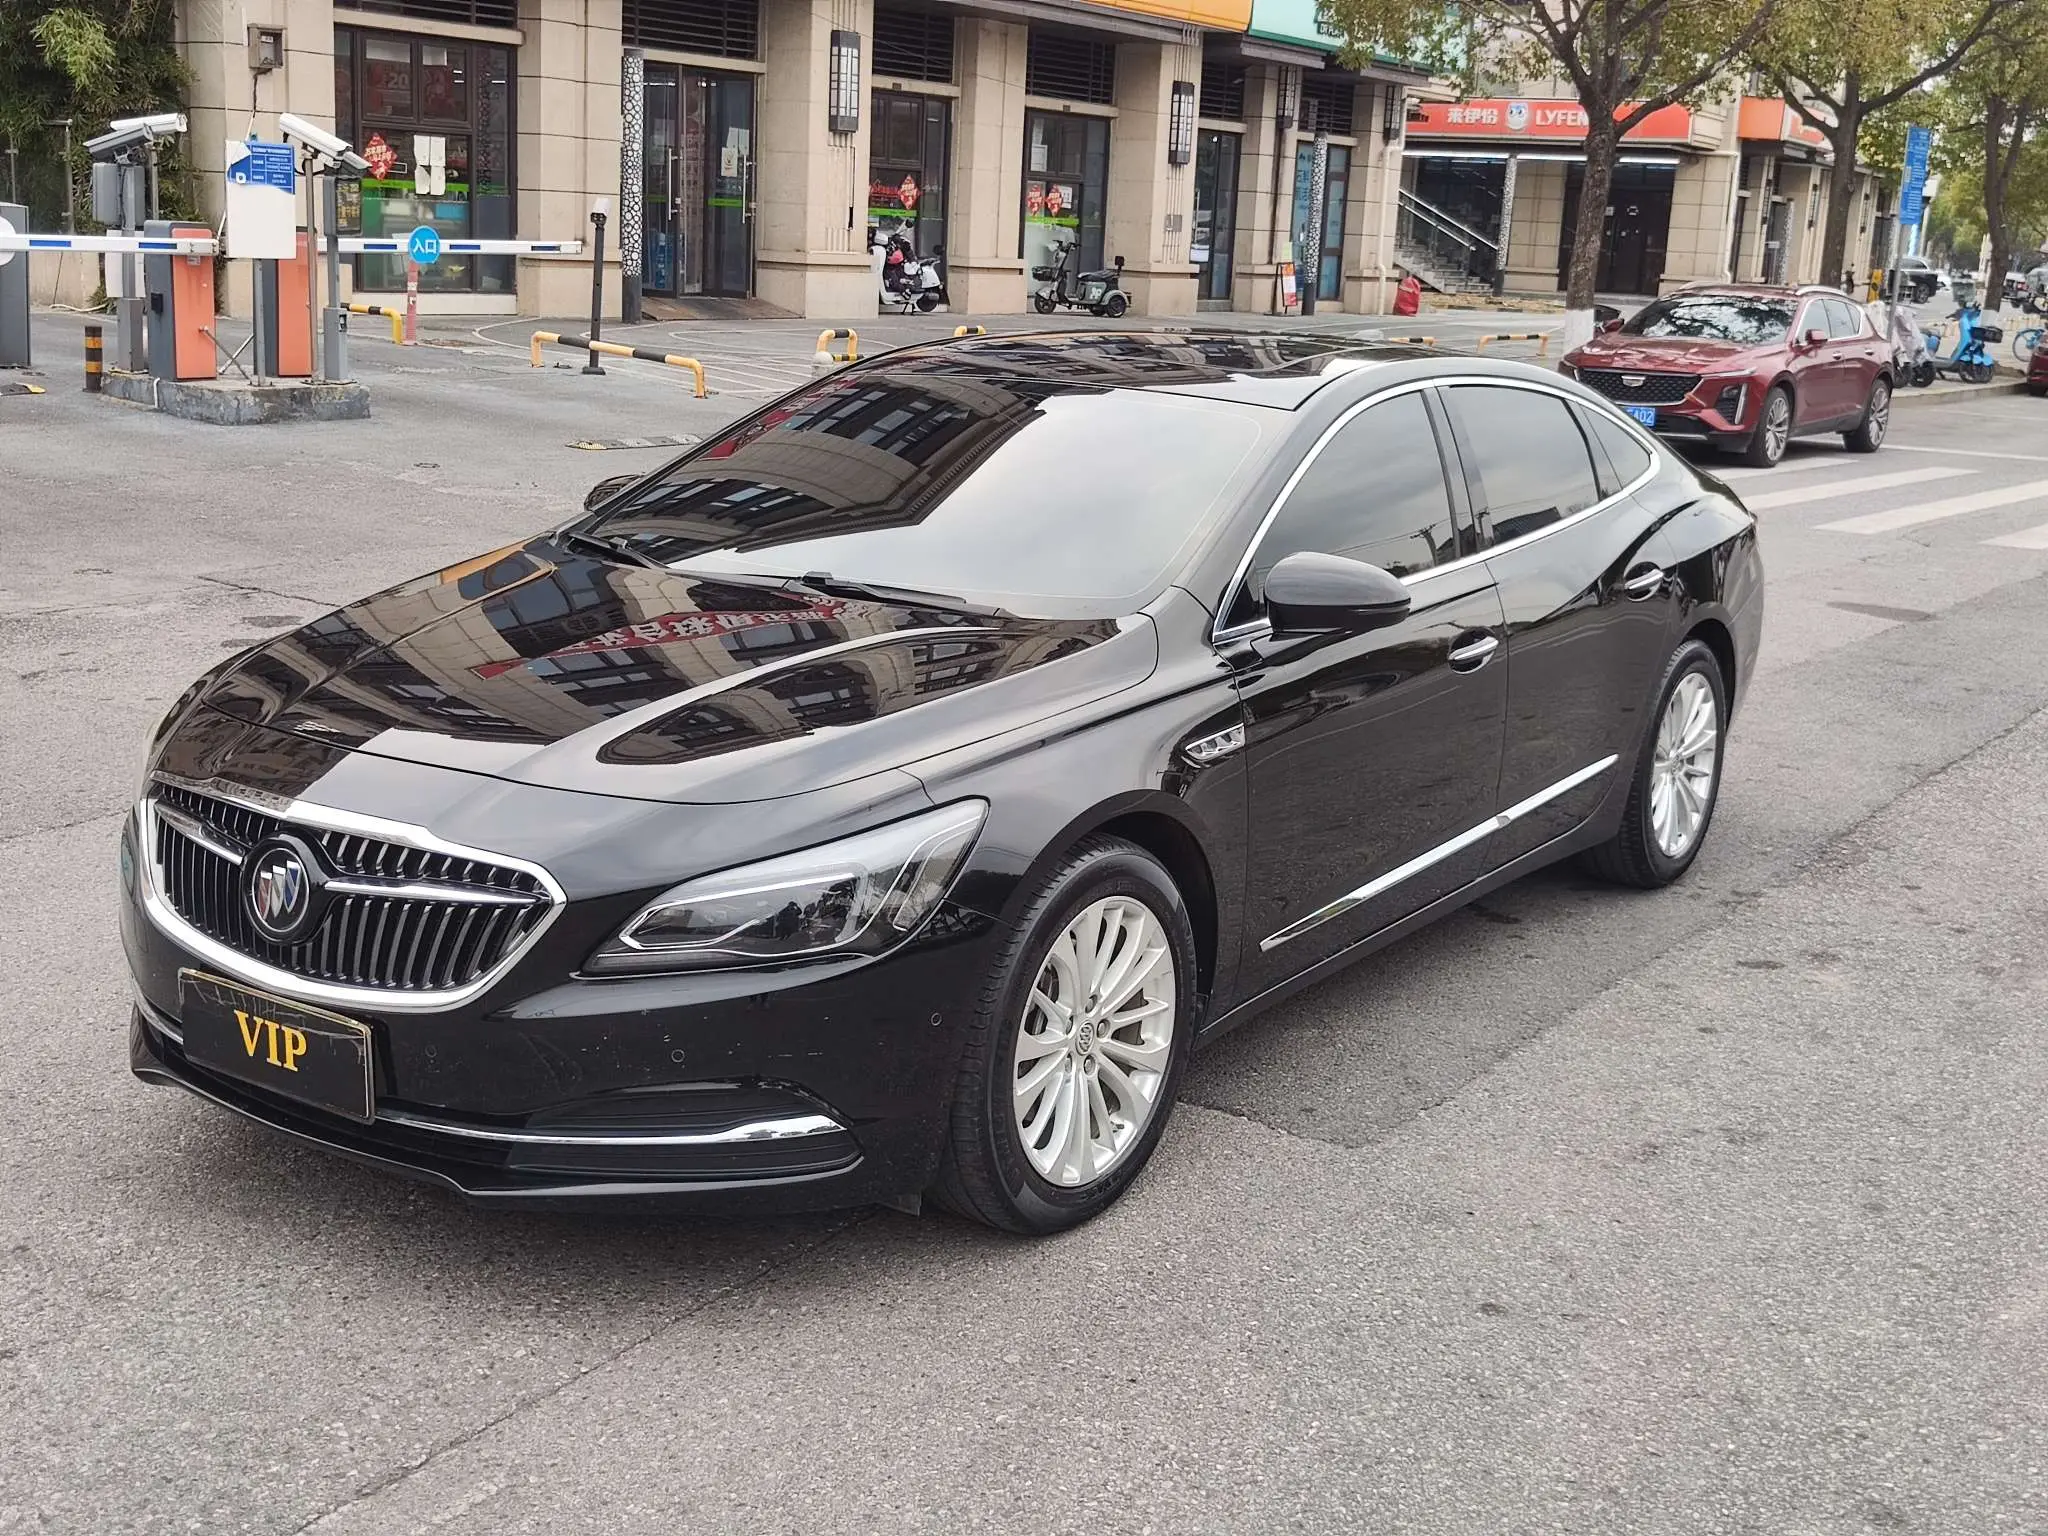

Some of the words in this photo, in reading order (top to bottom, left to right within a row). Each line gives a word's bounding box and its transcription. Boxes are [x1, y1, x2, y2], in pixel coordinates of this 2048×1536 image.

[1447, 107, 1499, 125] 来伊份
[413, 238, 437, 254] 入口
[233, 1009, 307, 1072] VIP
